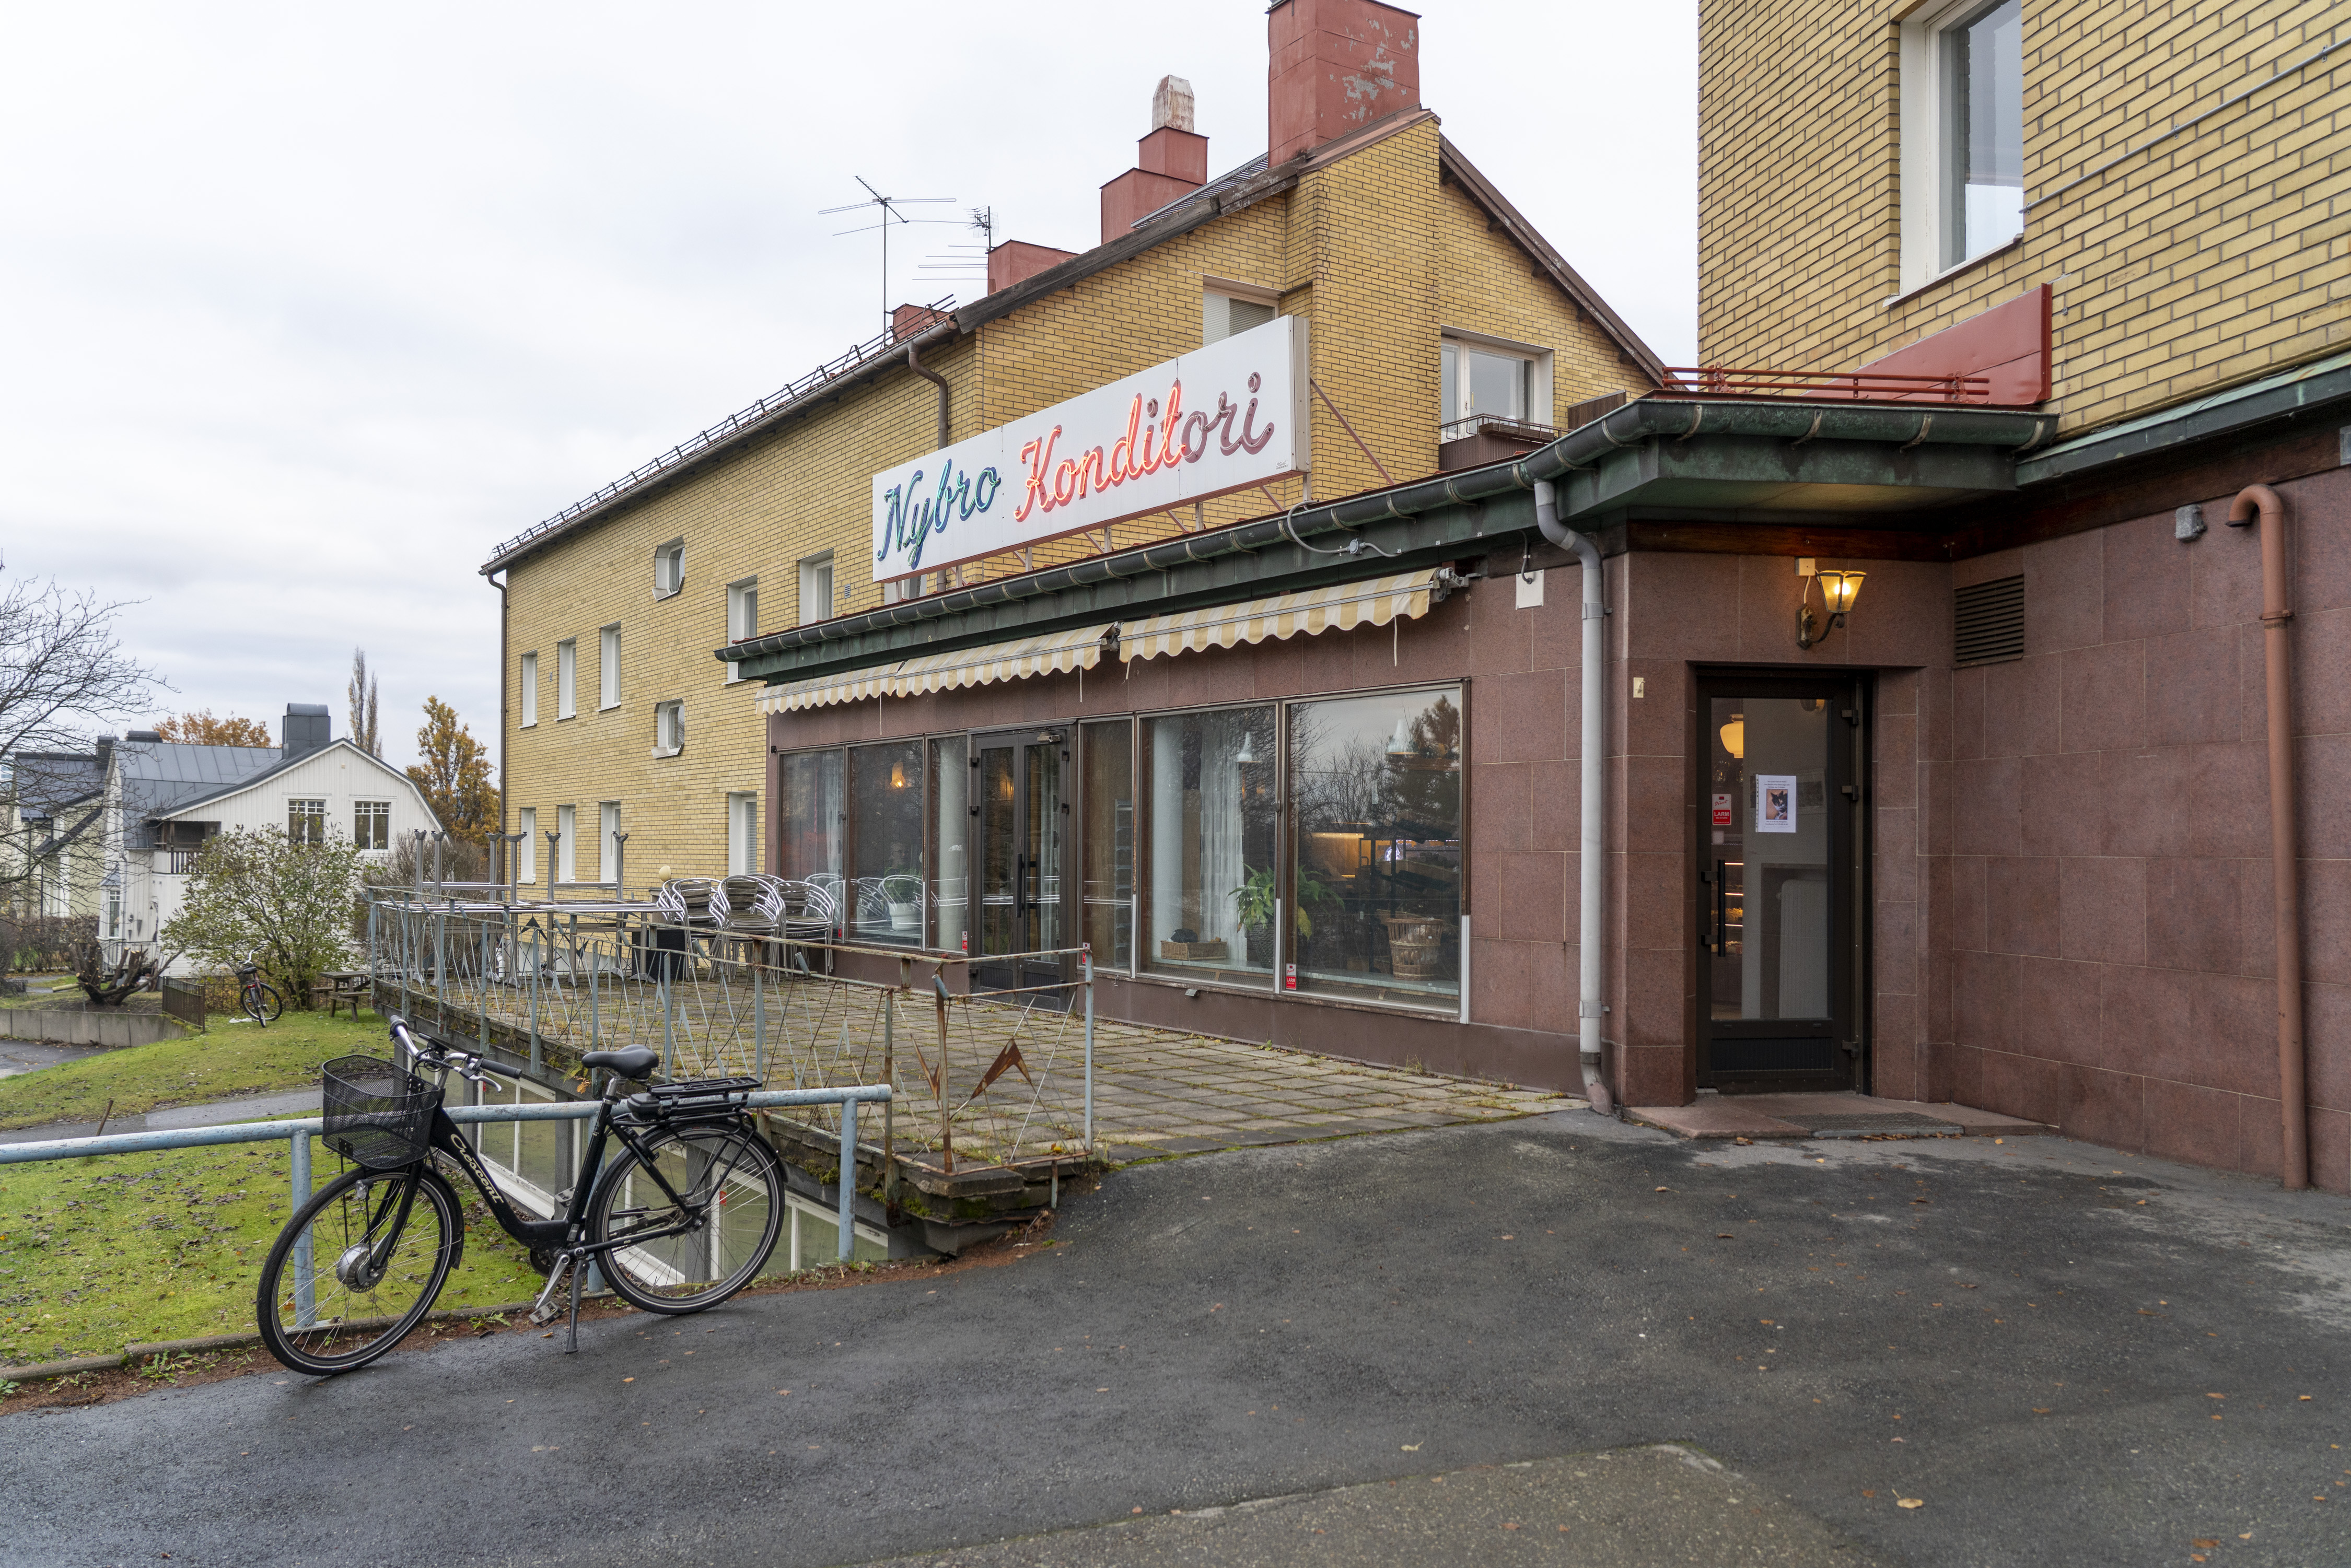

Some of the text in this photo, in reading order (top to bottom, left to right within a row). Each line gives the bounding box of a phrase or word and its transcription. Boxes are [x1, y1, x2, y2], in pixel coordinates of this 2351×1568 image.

[877, 372, 1274, 570] Nybro Konditori
[451, 1134, 504, 1203] Crescent
